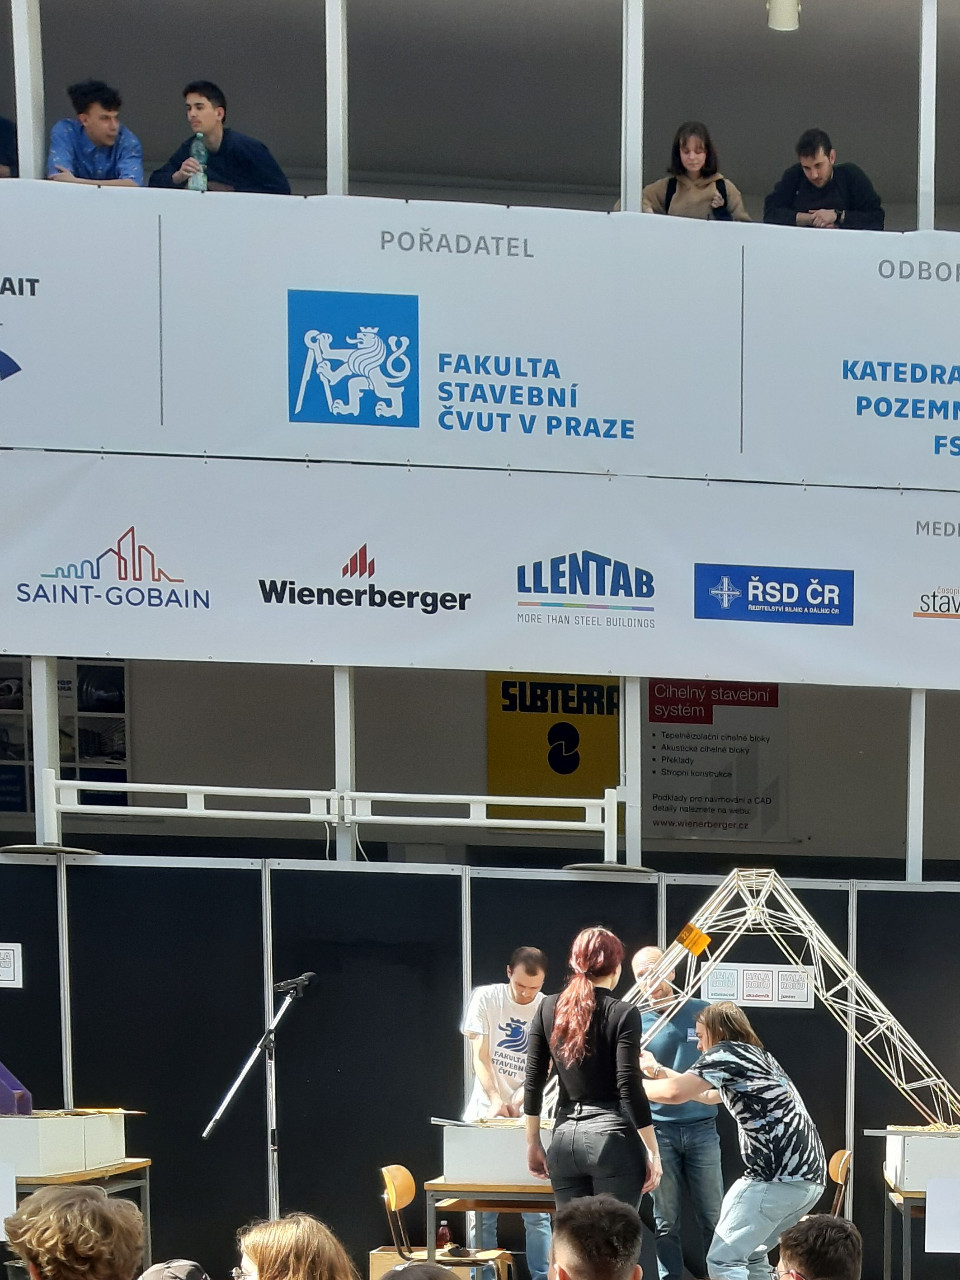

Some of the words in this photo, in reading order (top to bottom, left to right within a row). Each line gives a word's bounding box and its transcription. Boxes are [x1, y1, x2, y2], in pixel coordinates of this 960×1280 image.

[380, 228, 534, 258] POŘADATEL
[438, 353, 561, 379] FAKULTA
[438, 382, 579, 408] STAVEBNÍ
[438, 405, 511, 432] ČVUT
[519, 413, 537, 434] V
[546, 415, 635, 439] PRAZE
[517, 550, 655, 598] LLENTAB
[16, 583, 210, 609] SAINT-GOBAIN
[258, 579, 471, 615] Wienerberger
[748, 576, 799, 603] ŘSD
[806, 579, 840, 605] ČR
[517, 613, 542, 623] MORE
[546, 614, 570, 625] THAN
[574, 616, 602, 626] STEEL
[606, 617, 655, 628] BUILDINGS
[654, 684, 706, 702] Cihelný
[711, 688, 770, 701] stavební
[654, 703, 705, 718] systém
[491, 1057, 526, 1072] STAVEBN
[494, 1050, 526, 1065] FAKULTA
[498, 1066, 518, 1079] ČVUT
